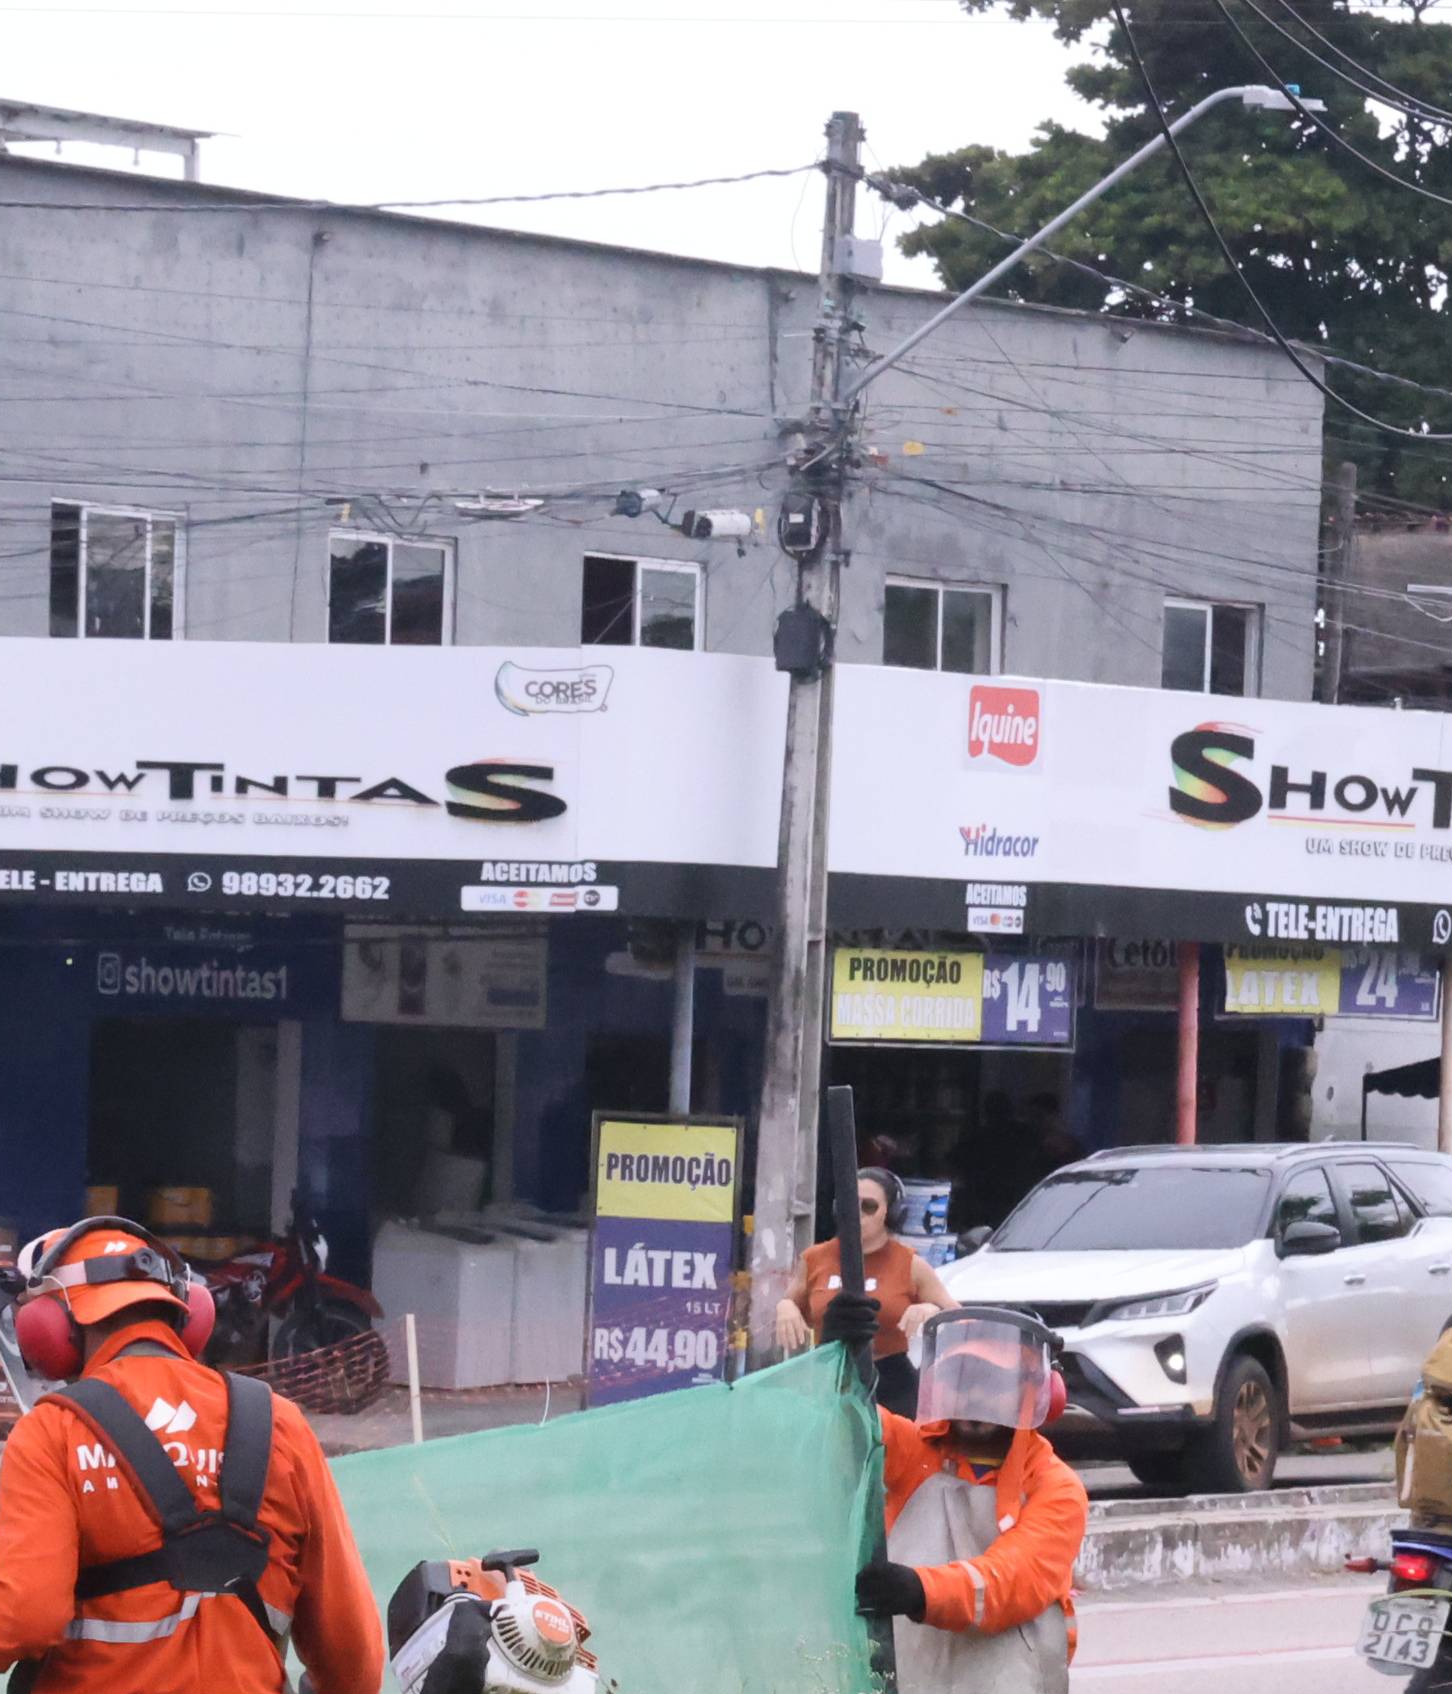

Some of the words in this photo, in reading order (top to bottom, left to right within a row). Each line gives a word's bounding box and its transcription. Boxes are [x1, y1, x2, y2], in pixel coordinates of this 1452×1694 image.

[525, 679, 597, 698] CORES
[970, 701, 1037, 755] Iquine
[959, 823, 1039, 857] Hidracor
[1305, 837, 1334, 854] UM
[1339, 839, 1388, 857] SHOW
[1394, 842, 1415, 859] DE
[55, 871, 164, 893] ENTREGA
[221, 871, 391, 900] 98932.2662
[480, 862, 597, 883] ACEITAMOS
[965, 883, 1027, 906] ACEITAMOS
[1266, 901, 1399, 942] TELE-ENTREGA
[849, 956, 961, 988] PROMOÇÃO
[838, 995, 895, 1027] MASSA
[900, 996, 976, 1029] CORRIDA
[606, 1151, 732, 1190] PROMOÇÃO
[604, 1243, 717, 1290] LÁTEX
[686, 1301, 702, 1313] 15
[704, 1302, 721, 1314] LT
[1363, 1633, 1429, 1663] 2143
